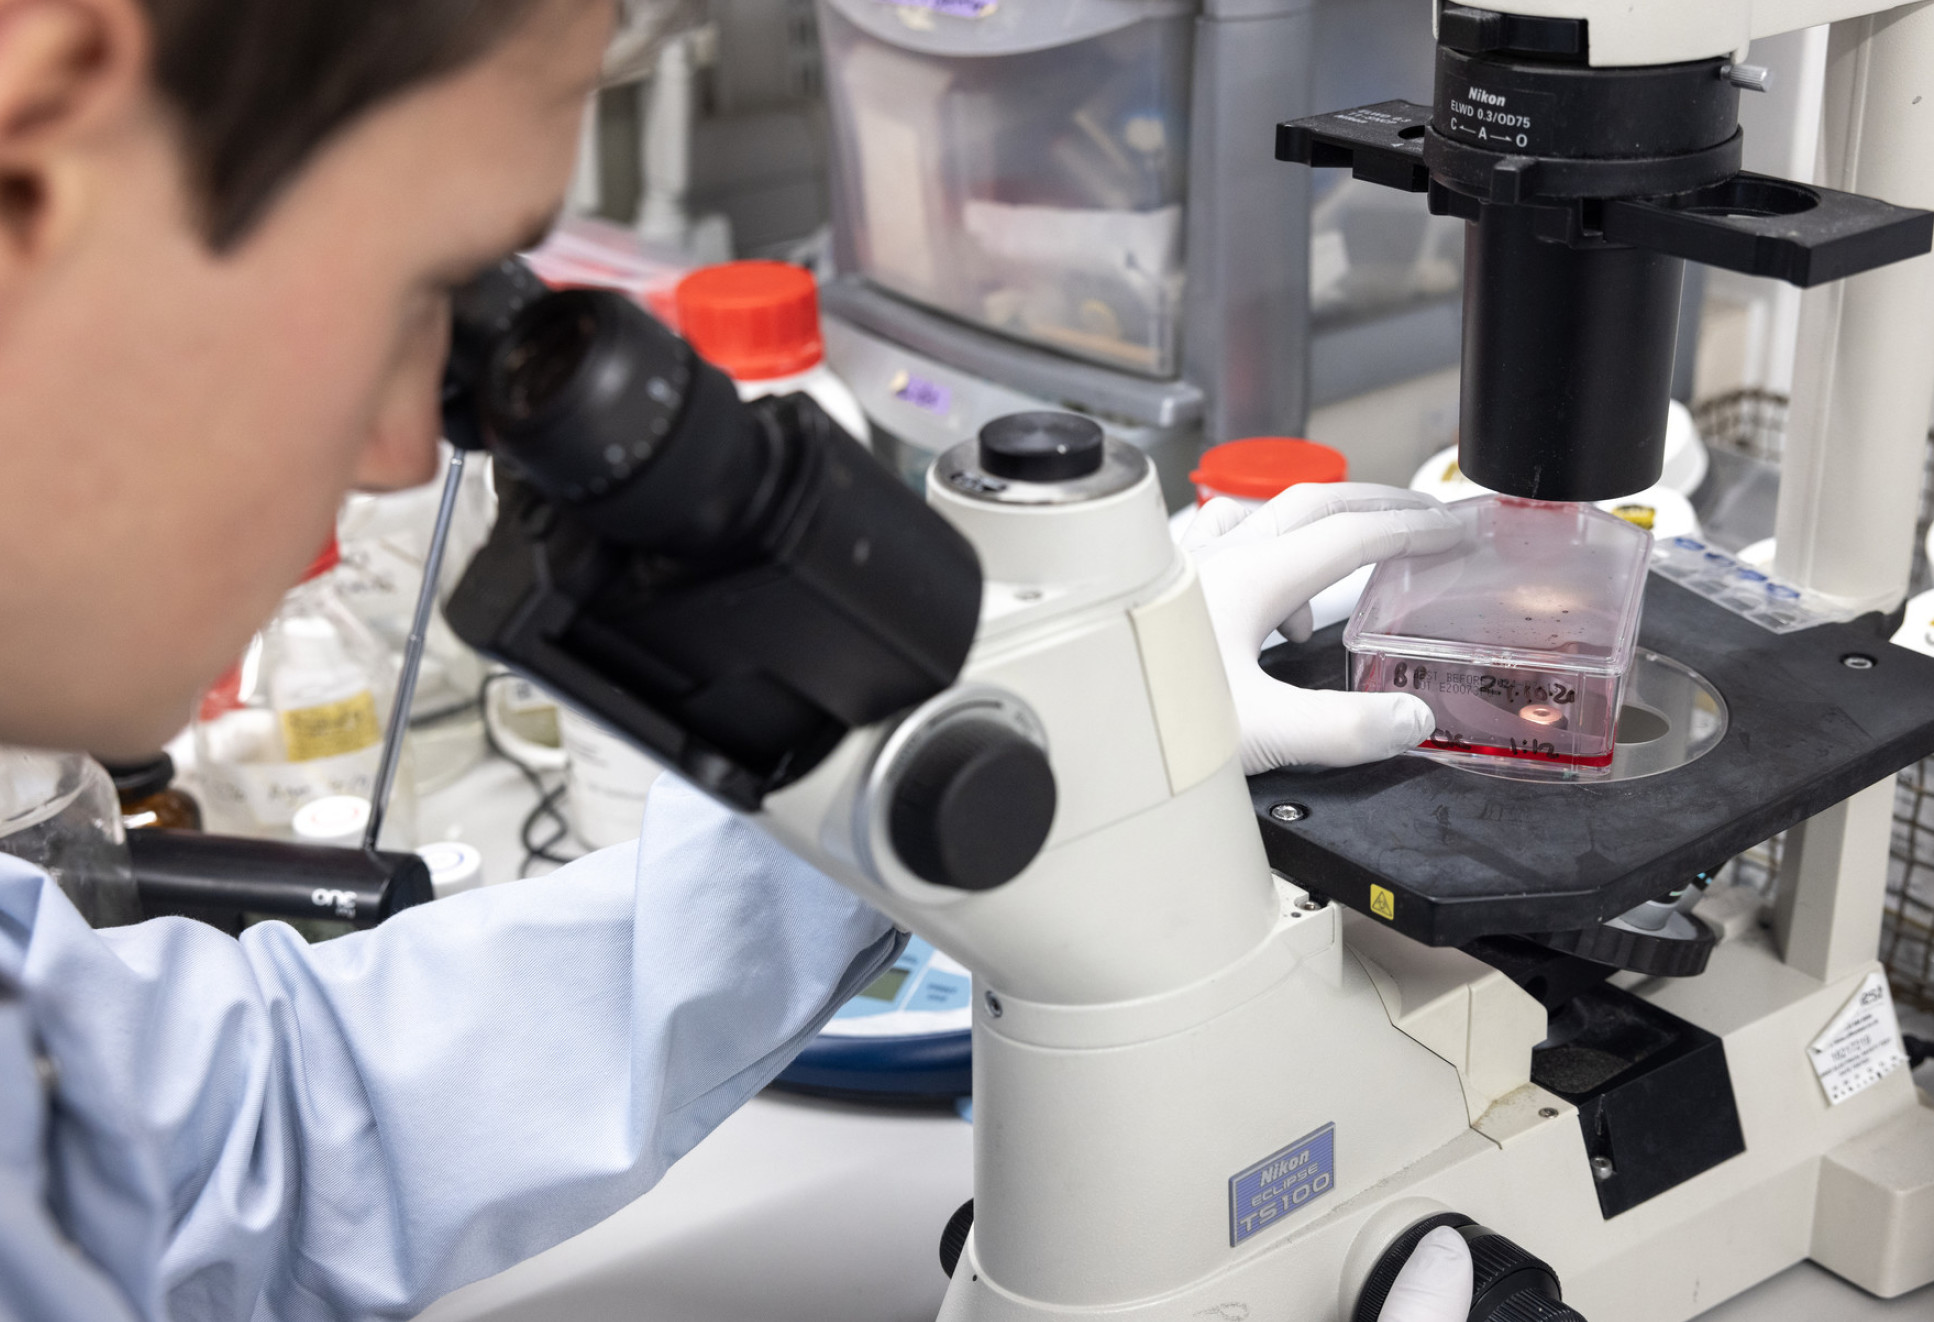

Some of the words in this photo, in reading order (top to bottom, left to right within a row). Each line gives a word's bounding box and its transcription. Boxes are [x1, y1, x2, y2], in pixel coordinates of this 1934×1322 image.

[1468, 86, 1506, 107] Nikon
[1451, 99, 1475, 117] ELWD
[1477, 108, 1531, 129] 0.3/OD75
[1450, 117, 1457, 131] C
[1478, 126, 1488, 140] A
[1515, 133, 1528, 148] O
[1251, 1162, 1318, 1207] ECLIPSE
[1260, 1151, 1310, 1187] Nikon
[1240, 1172, 1330, 1232] TS100
